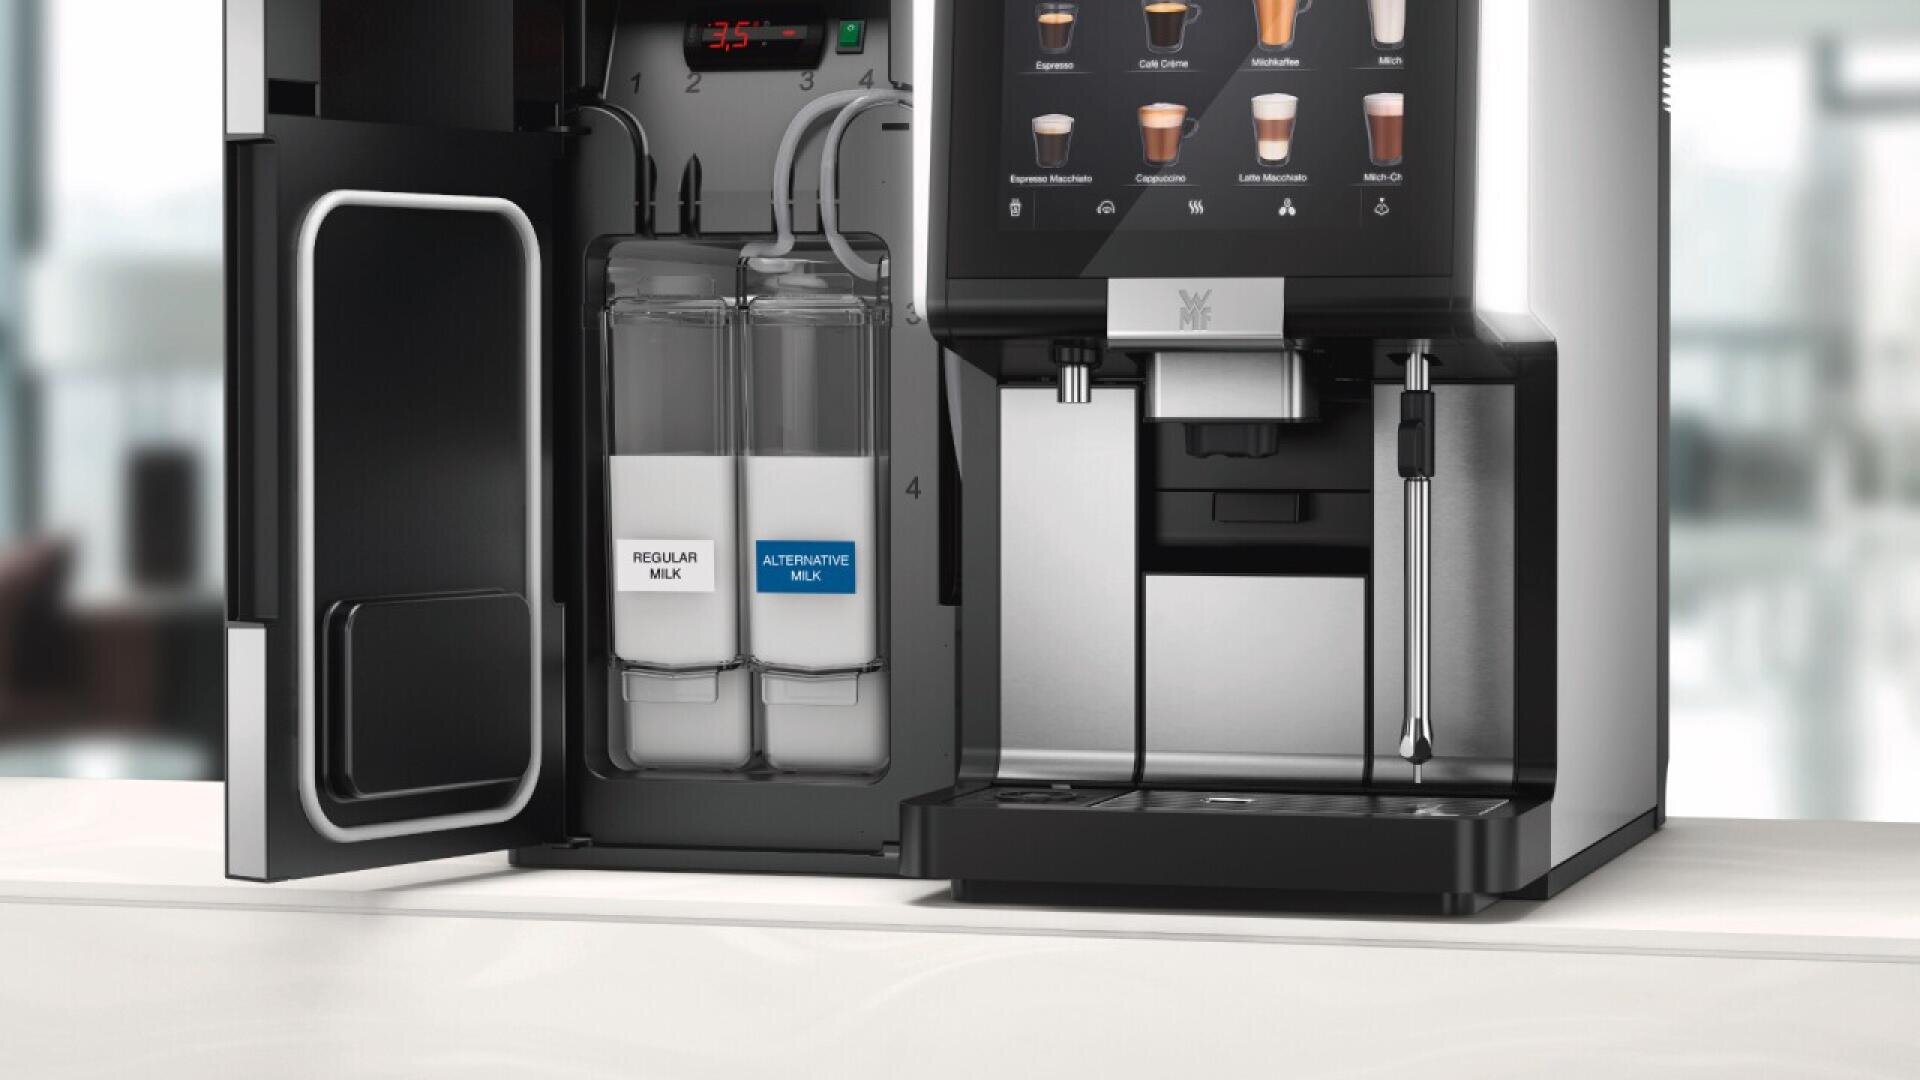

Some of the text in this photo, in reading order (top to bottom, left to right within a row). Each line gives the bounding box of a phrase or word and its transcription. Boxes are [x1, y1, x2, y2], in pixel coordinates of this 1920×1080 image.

[1035, 60, 1074, 71] Espresso
[1139, 58, 1189, 69] Café Crème
[1251, 57, 1300, 67] Milchkaffee
[630, 72, 642, 94] 1
[686, 72, 702, 94] 2
[800, 71, 815, 91] 3
[858, 69, 874, 90] 4
[1010, 173, 1093, 185] Espresso Macchiato
[1136, 173, 1186, 185] Cappuccino
[1238, 173, 1308, 183] Latte Macchiato
[905, 476, 922, 499] 4
[633, 551, 697, 563] REGULAR
[763, 554, 850, 567] ALTERNATIVE
[650, 568, 681, 580] MILK
[791, 570, 821, 582] MILK
